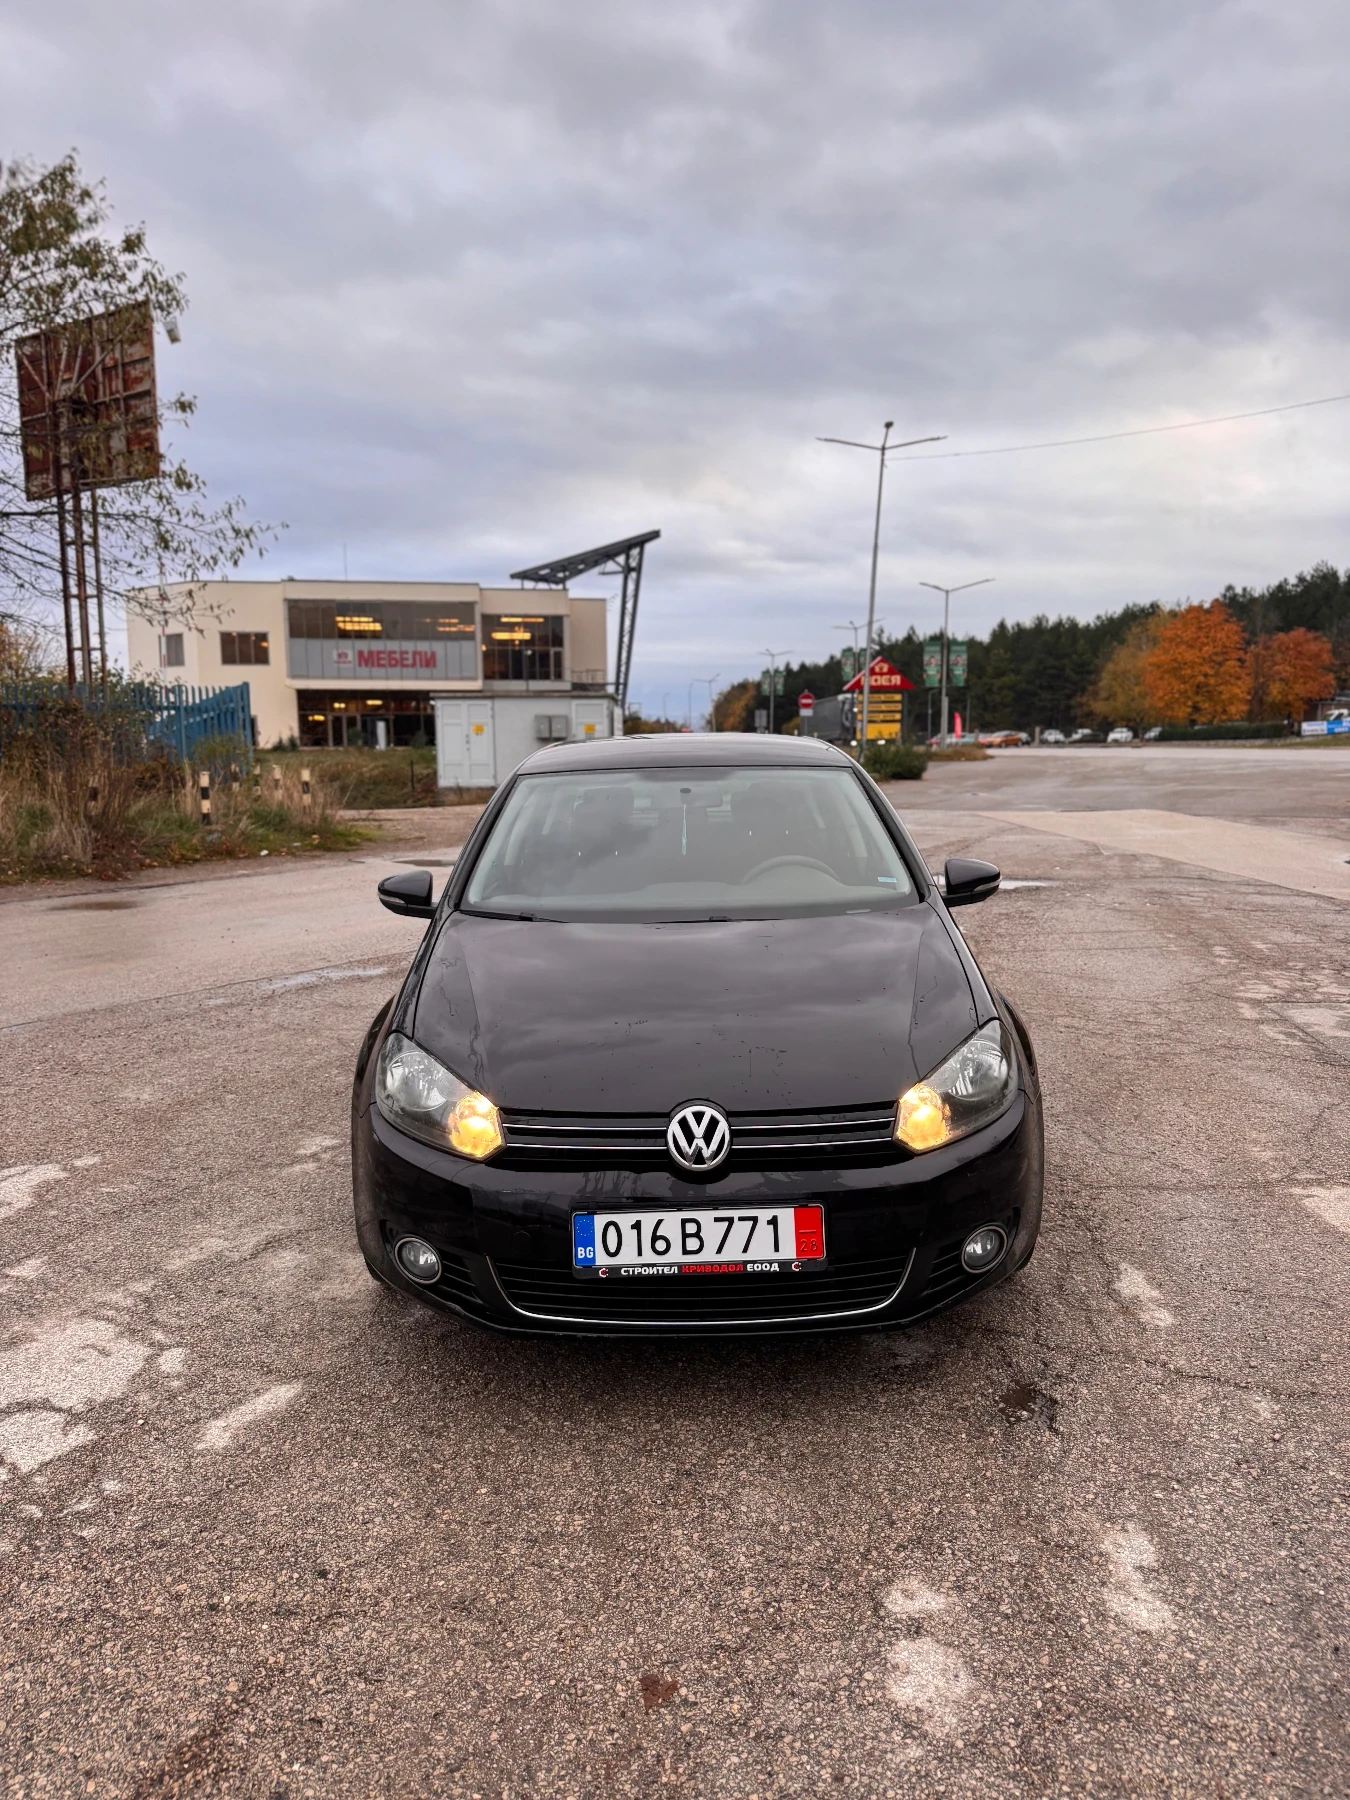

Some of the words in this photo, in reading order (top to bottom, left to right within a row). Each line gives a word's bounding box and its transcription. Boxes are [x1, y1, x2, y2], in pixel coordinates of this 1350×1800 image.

[357, 649, 437, 669] МЕБЕЛИ
[601, 1214, 780, 1258] 016B771
[577, 1246, 594, 1259] BG
[799, 1238, 818, 1253] 28
[620, 1265, 679, 1275] СТРОИТЕЛ
[681, 1263, 744, 1274] КРИВОДОЛ
[746, 1262, 780, 1272] ЕООД
